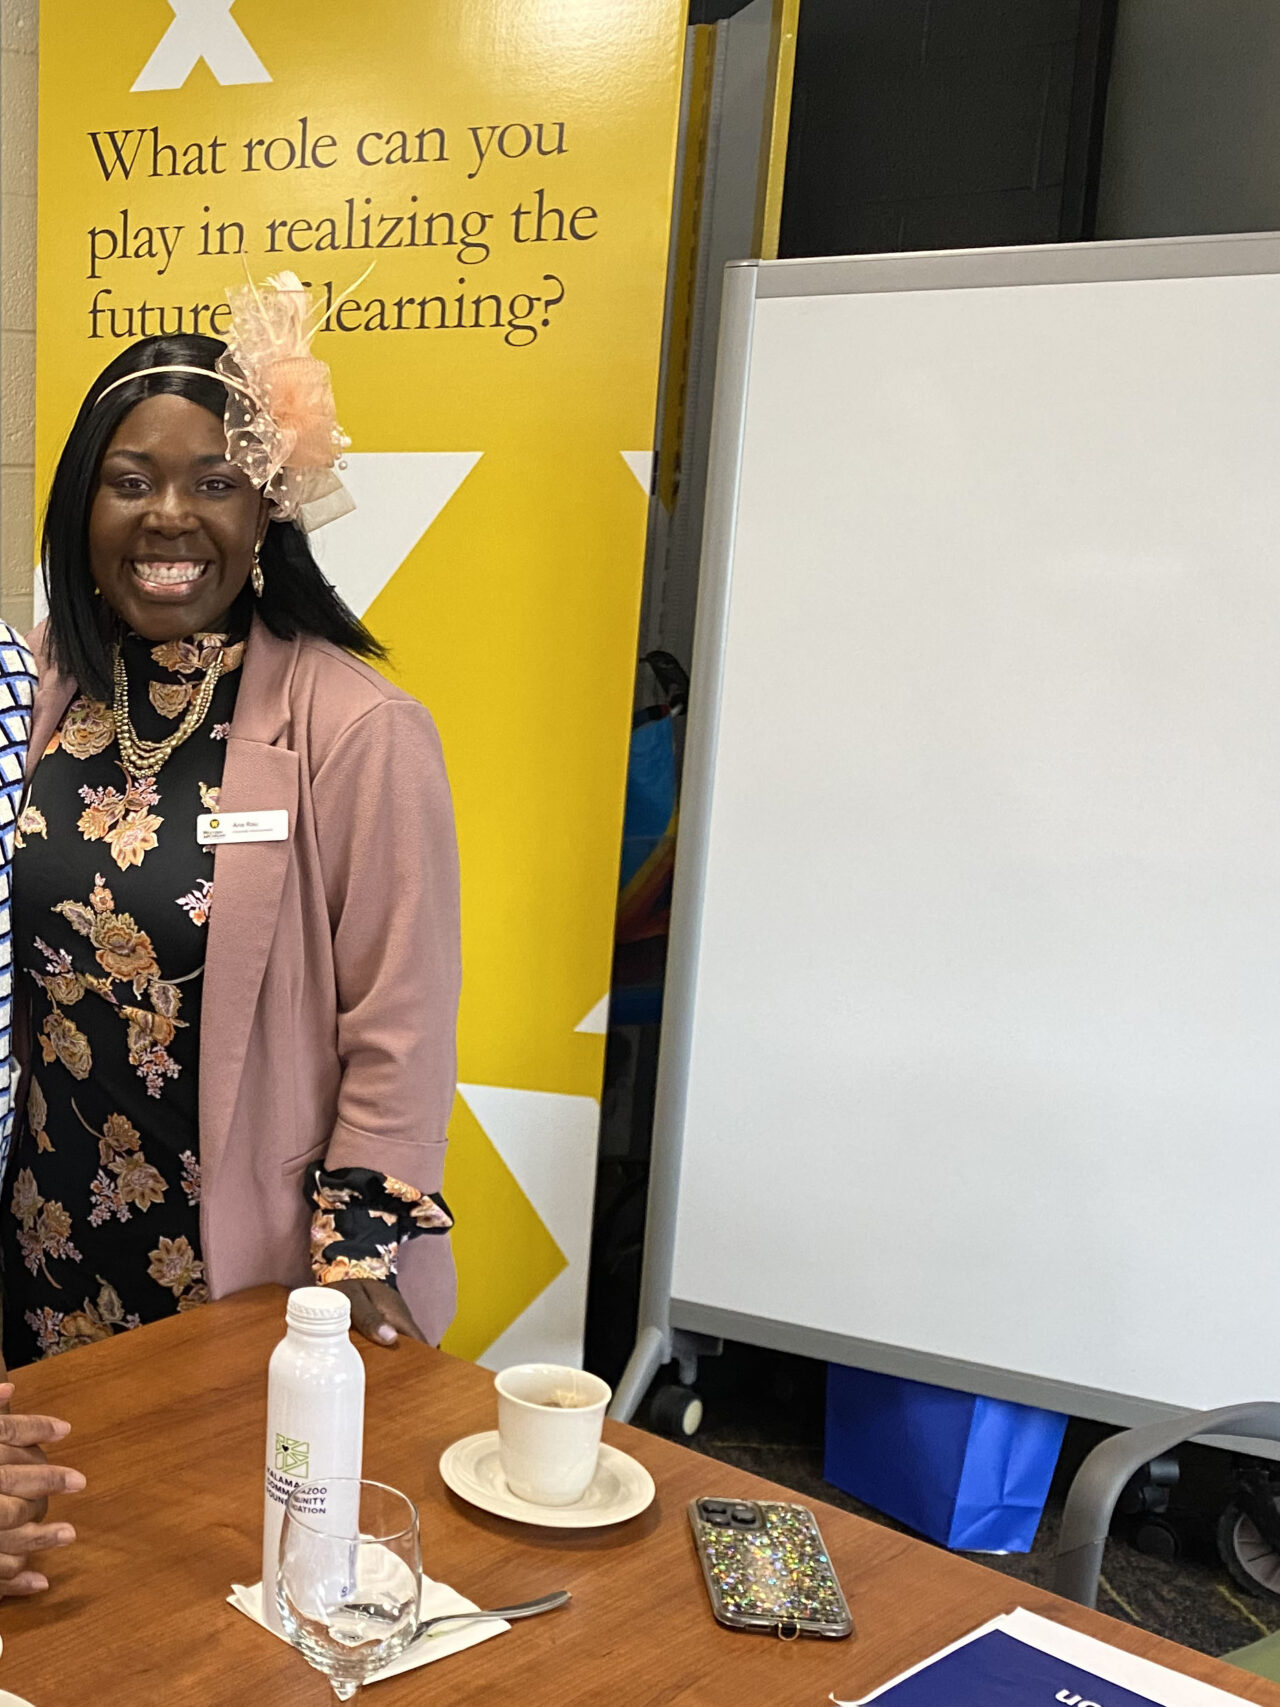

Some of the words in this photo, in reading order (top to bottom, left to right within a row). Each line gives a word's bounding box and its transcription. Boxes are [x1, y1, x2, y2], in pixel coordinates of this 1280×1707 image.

[87, 126, 227, 182] What
[242, 117, 337, 172] role
[355, 126, 448, 167] can
[467, 120, 568, 180] you
[86, 209, 186, 279] play
[199, 205, 246, 257] in
[265, 195, 494, 265] realizing
[511, 188, 599, 245] the
[86, 288, 232, 339] future
[319, 274, 567, 348] learning?
